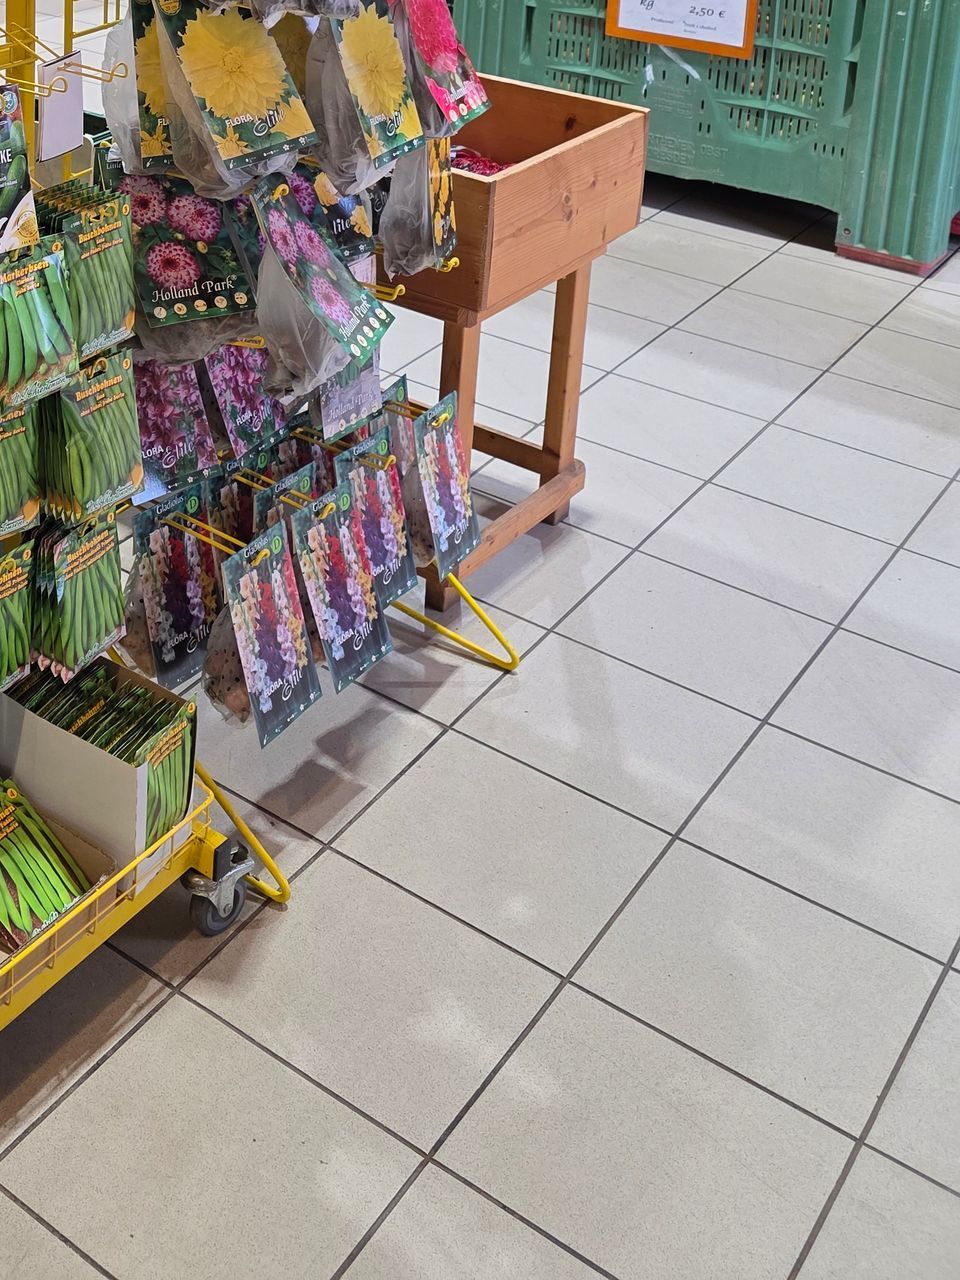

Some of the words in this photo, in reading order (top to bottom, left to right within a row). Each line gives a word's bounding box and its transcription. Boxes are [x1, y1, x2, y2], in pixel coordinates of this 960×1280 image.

[689, 6, 714, 16] 2,50
[719, 10, 727, 18] €
[225, 113, 254, 130] FLORA
[252, 108, 285, 137] Elite
[385, 112, 405, 137] Elite
[151, 284, 199, 303] Holland
[75, 374, 123, 401] Buschbohnen
[156, 496, 185, 515] Gladiolus
[264, 678, 284, 699] FLORA
[281, 670, 303, 701] Elite
